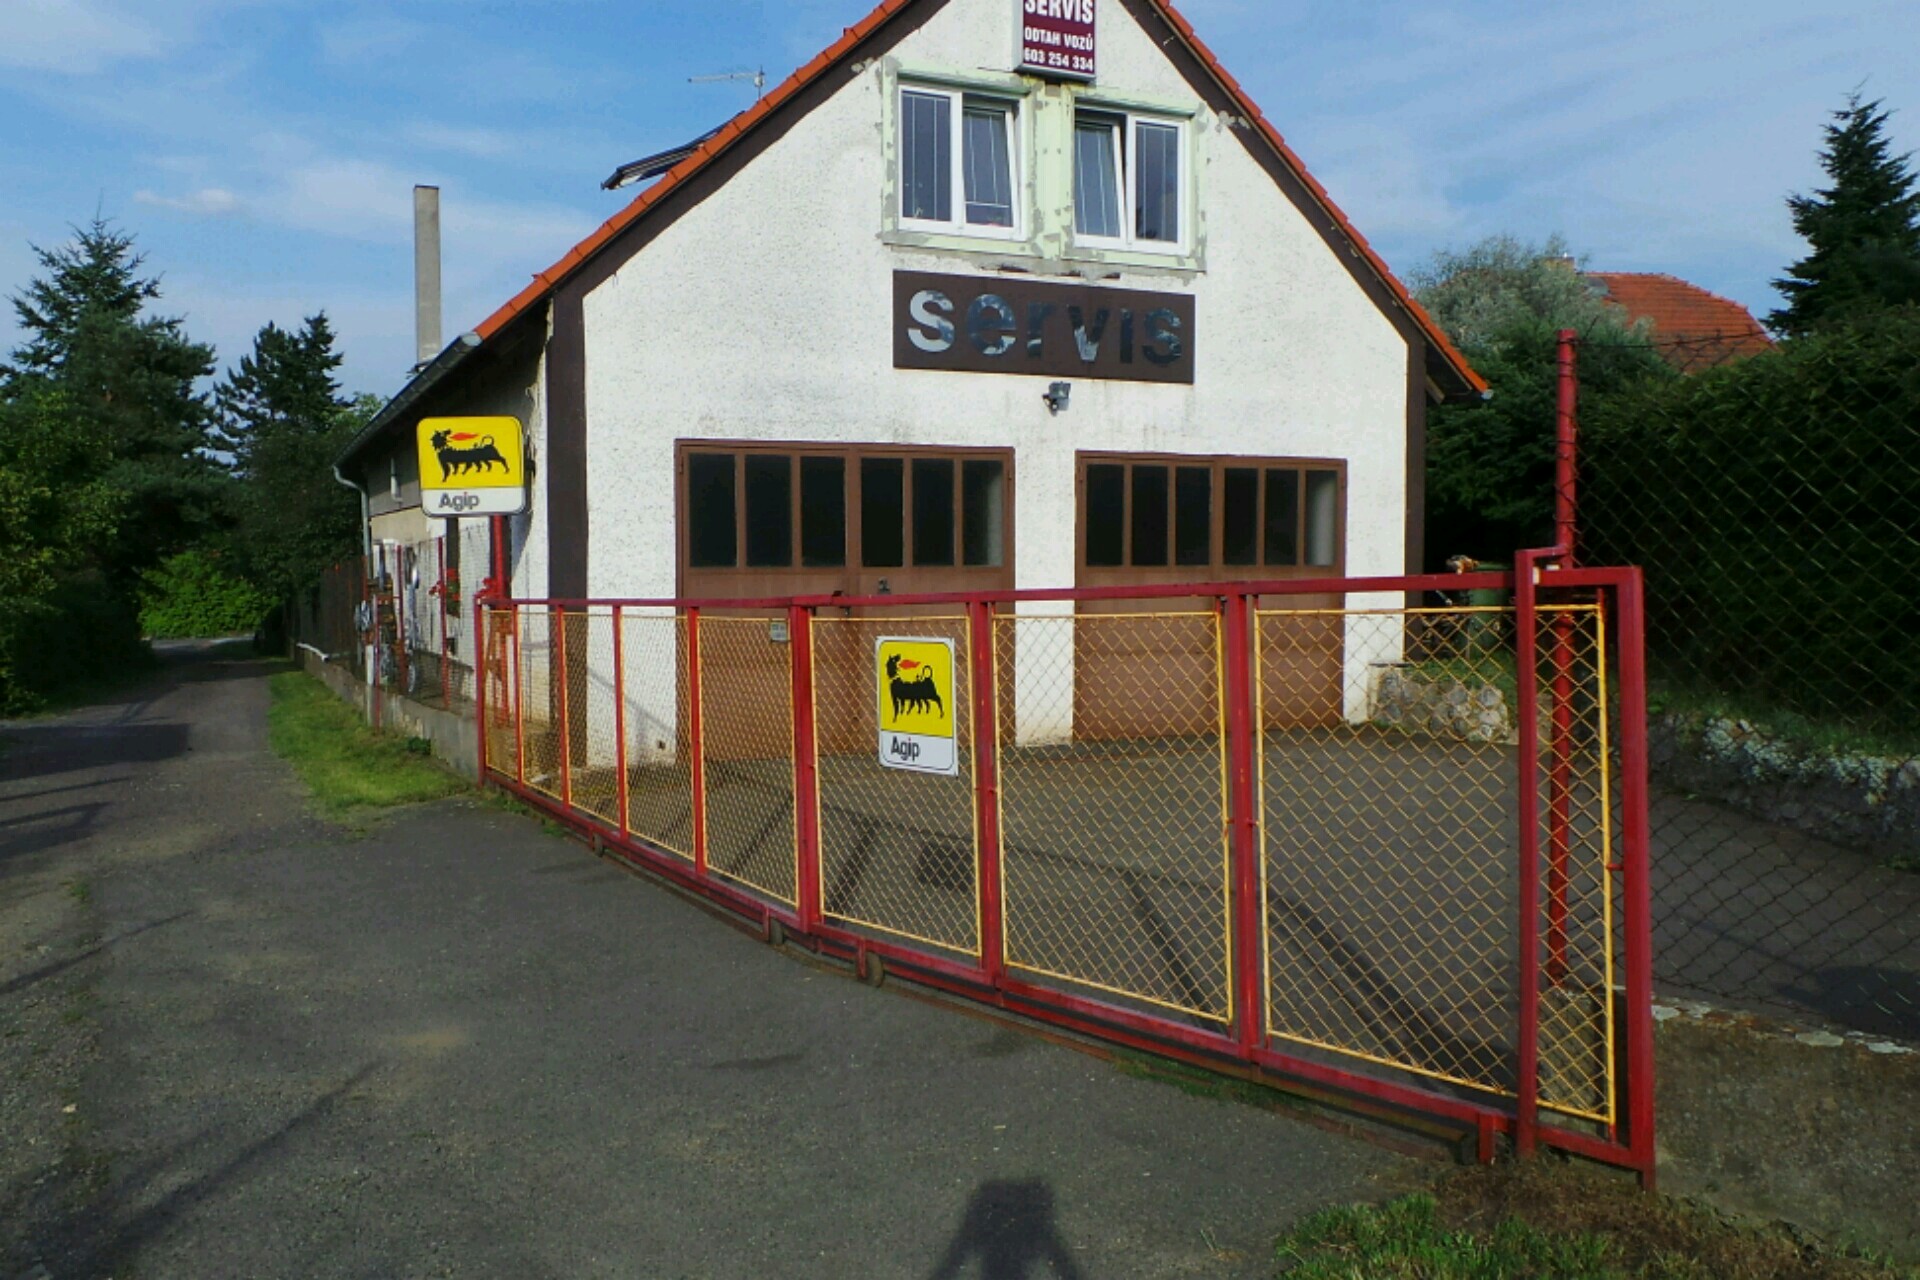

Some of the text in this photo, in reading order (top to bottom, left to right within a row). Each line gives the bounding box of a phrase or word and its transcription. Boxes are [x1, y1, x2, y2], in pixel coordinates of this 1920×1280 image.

[1024, 0, 1093, 24] SERVIS
[1024, 26, 1061, 46] ODTAH
[1048, 51, 1069, 67] 254
[1072, 55, 1093, 71] 334
[439, 492, 479, 512] Agip
[890, 736, 920, 761] Agip
